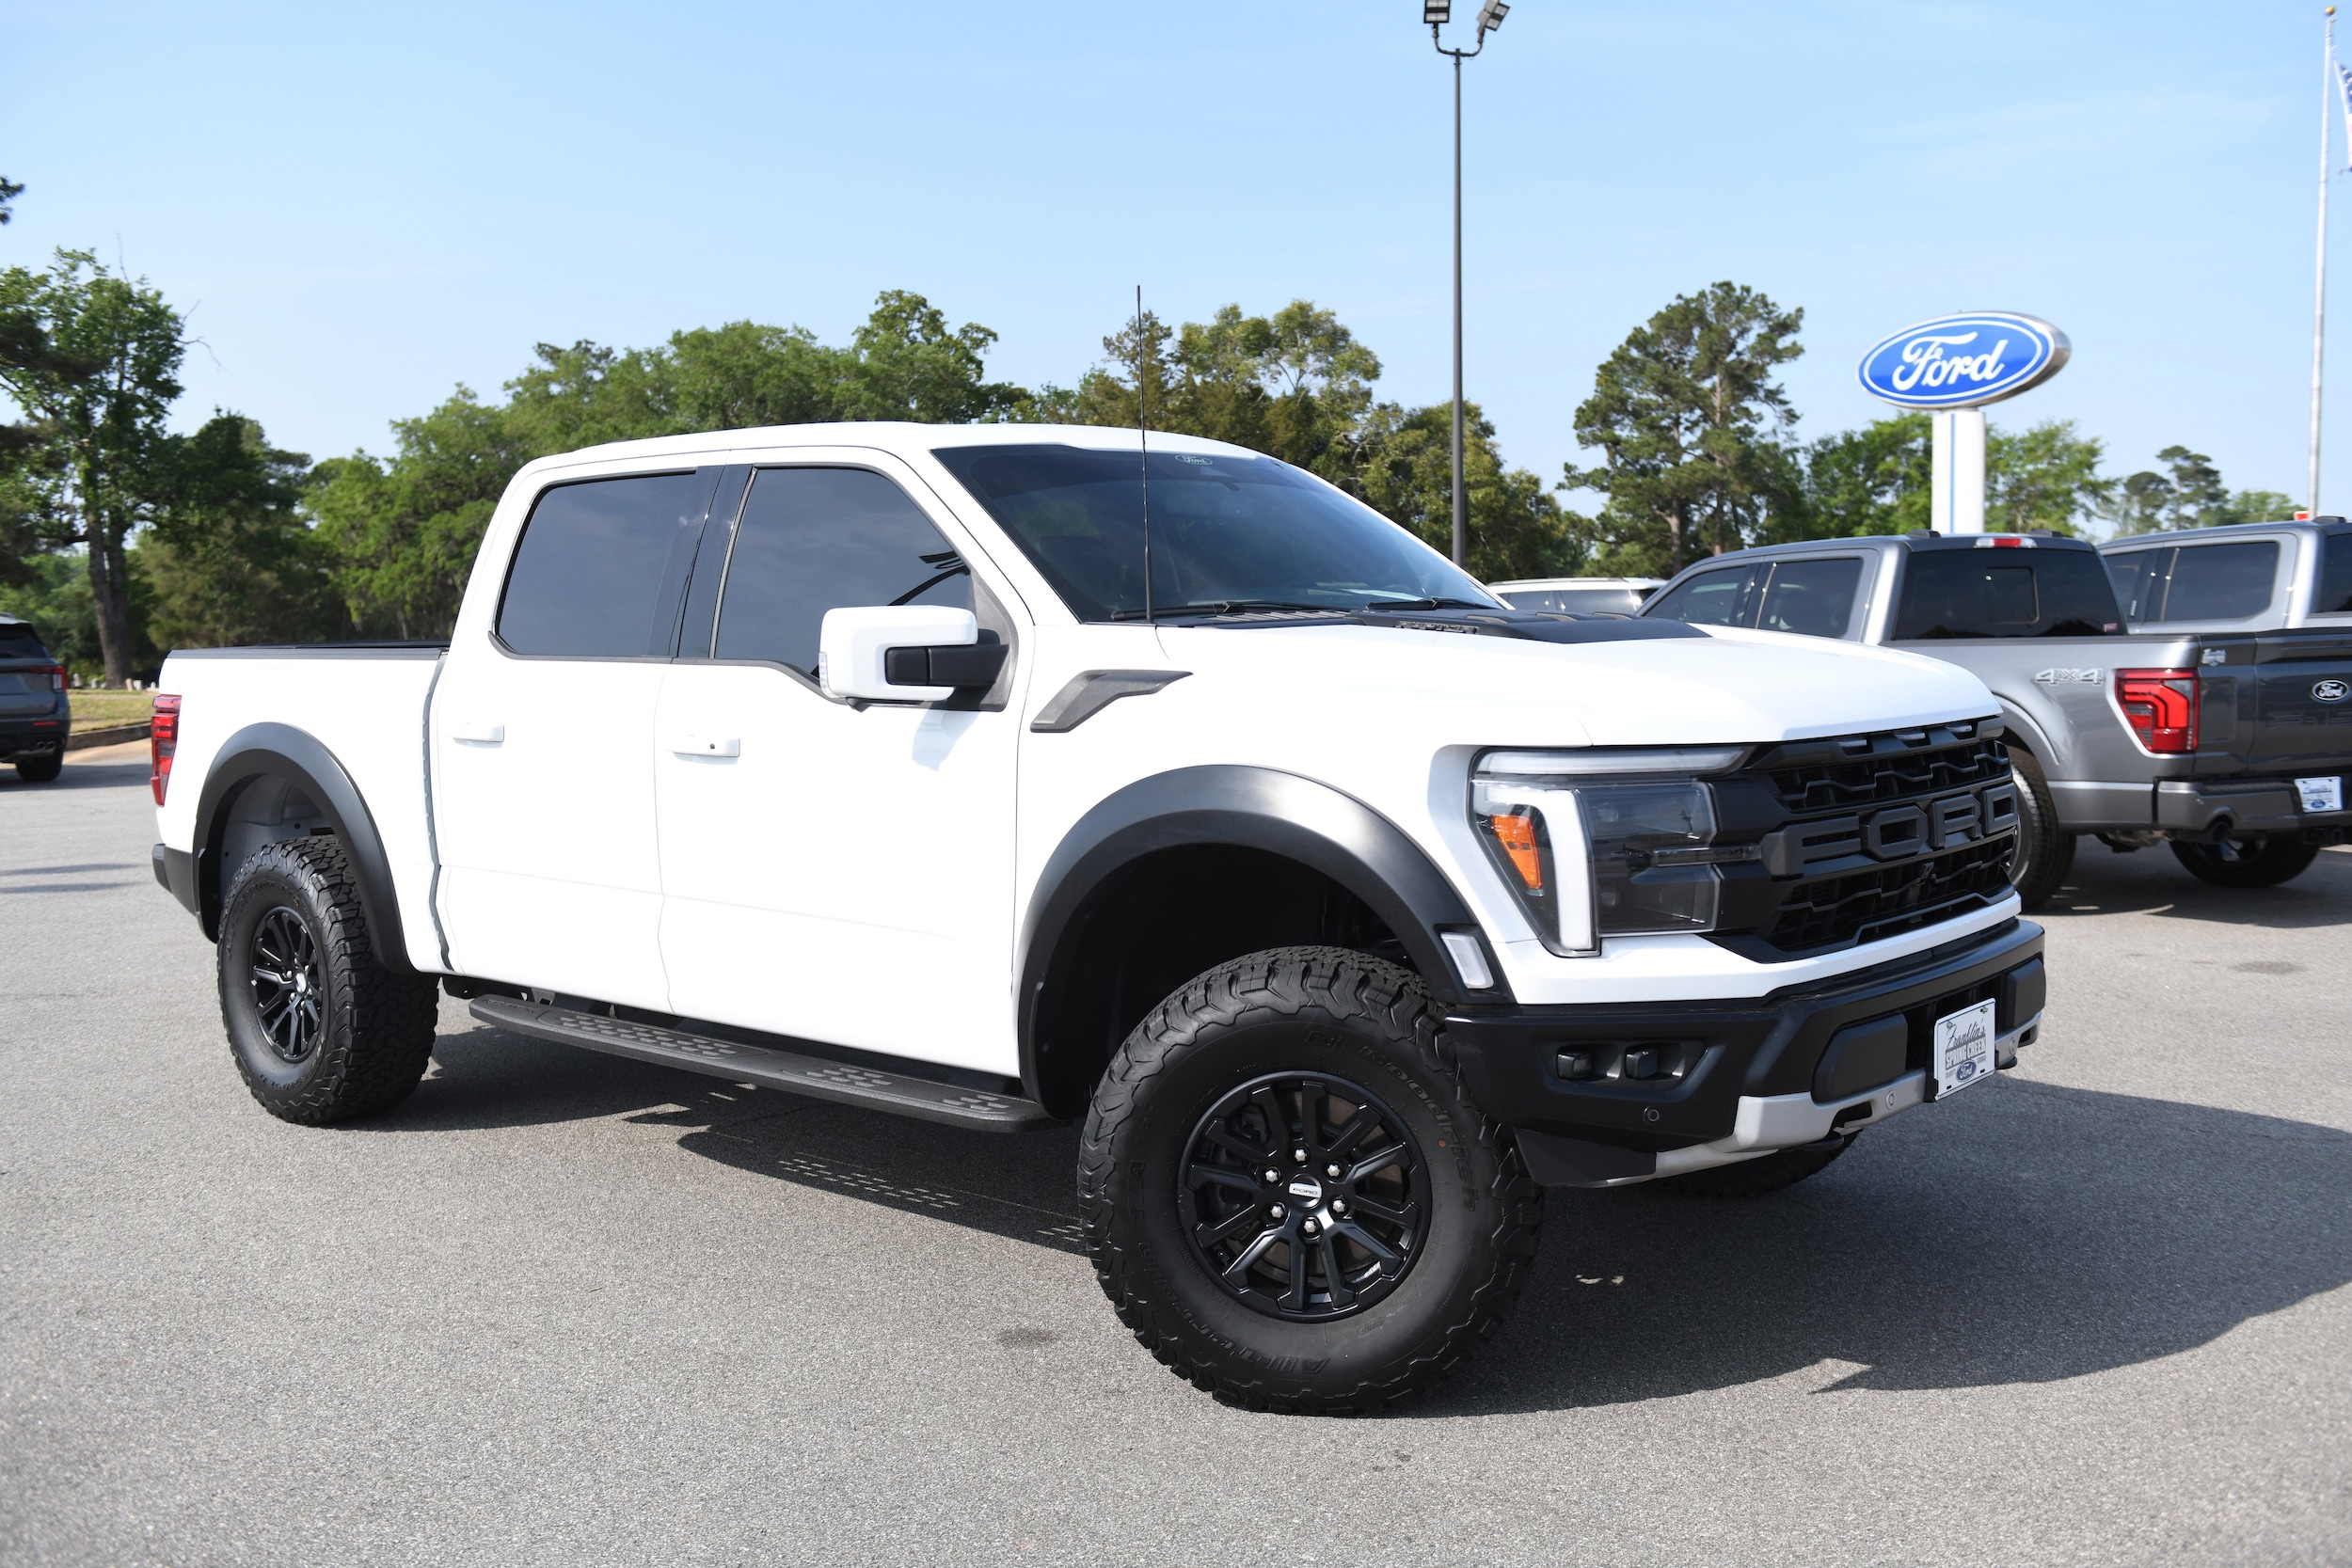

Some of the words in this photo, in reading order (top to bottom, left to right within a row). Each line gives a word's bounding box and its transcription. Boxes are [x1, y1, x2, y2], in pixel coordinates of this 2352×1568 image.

[1892, 331, 2009, 391] Ford
[1182, 455, 1208, 464] Ford
[2319, 683, 2343, 697] Ford
[1761, 783, 2018, 880] FORD
[1947, 1049, 1966, 1069] SPRING
[1967, 1039, 1986, 1059] CREEK
[1960, 1063, 1973, 1079] Ford
